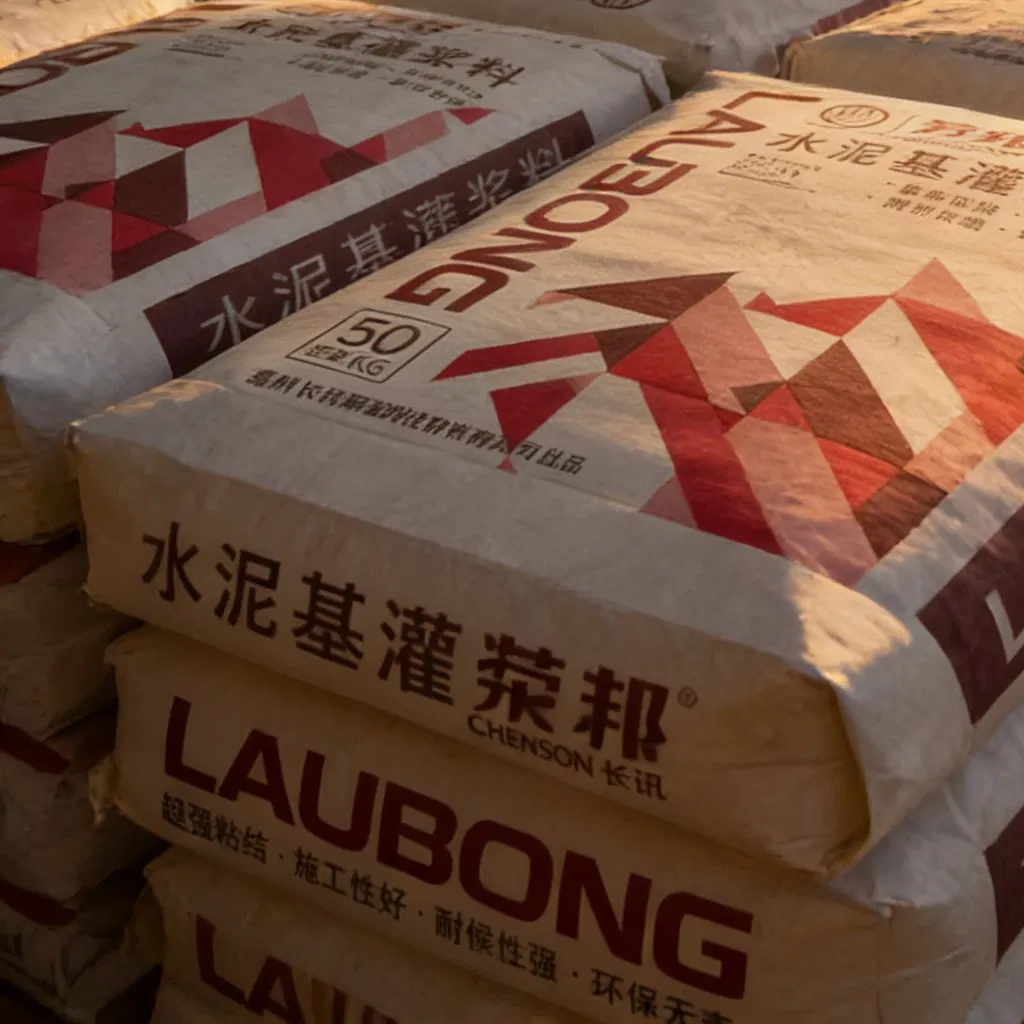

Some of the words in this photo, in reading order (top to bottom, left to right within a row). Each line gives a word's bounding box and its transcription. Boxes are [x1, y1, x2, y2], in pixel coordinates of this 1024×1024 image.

[384, 90, 822, 313] LAUBONG
[337, 317, 420, 355] 50
[468, 714, 594, 778] CHENSON
[164, 695, 753, 1000] LAUBONG
